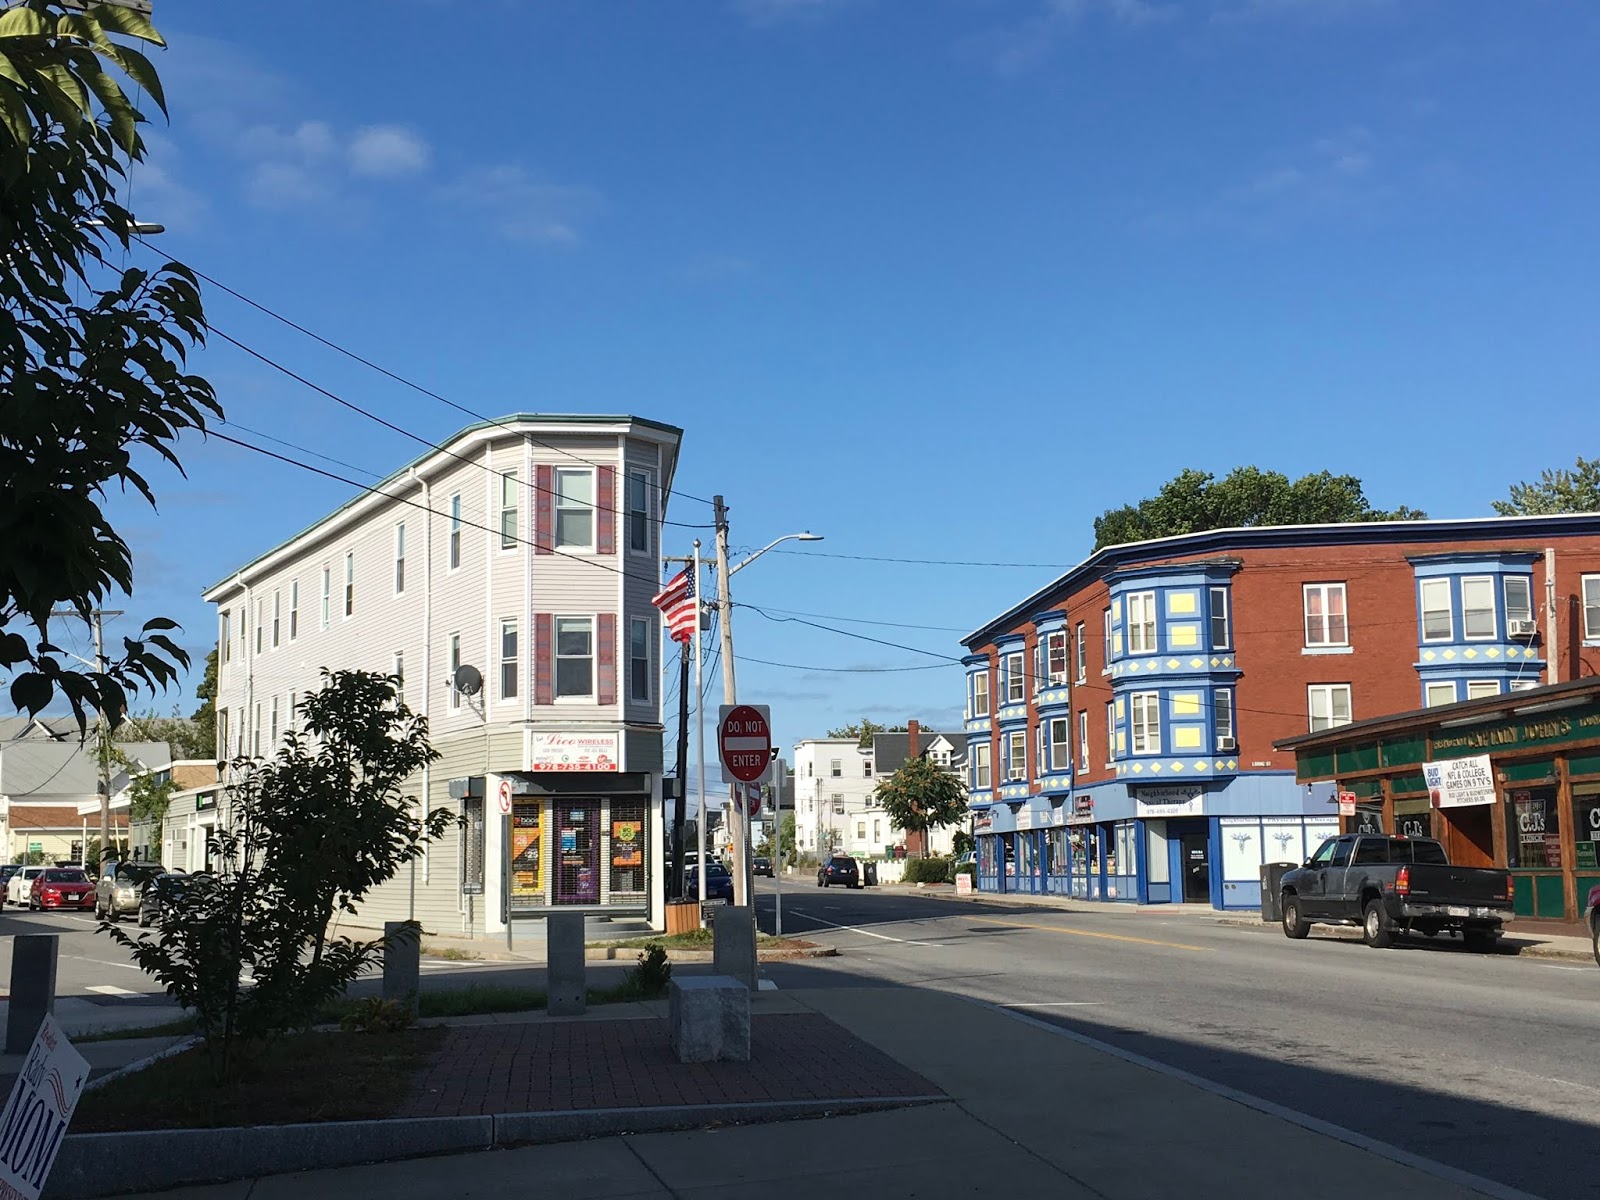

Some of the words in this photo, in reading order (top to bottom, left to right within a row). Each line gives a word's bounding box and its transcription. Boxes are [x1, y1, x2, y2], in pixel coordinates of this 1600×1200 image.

[728, 721, 740, 732] DO
[745, 721, 762, 732] NOT
[732, 754, 761, 767] ENTER
[1452, 761, 1468, 771] CATCH
[1469, 759, 1479, 768] ALL
[1427, 767, 1439, 777] BUD
[1447, 771, 1457, 780] NFL
[1462, 768, 1486, 778] COLLEGE
[1427, 777, 1442, 787] LIGHT
[1446, 780, 1463, 790] GAMES
[1464, 779, 1472, 788] ON
[1473, 779, 1477, 787] 9
[1477, 777, 1492, 786] TV'S
[24, 1043, 48, 1092] Rady
